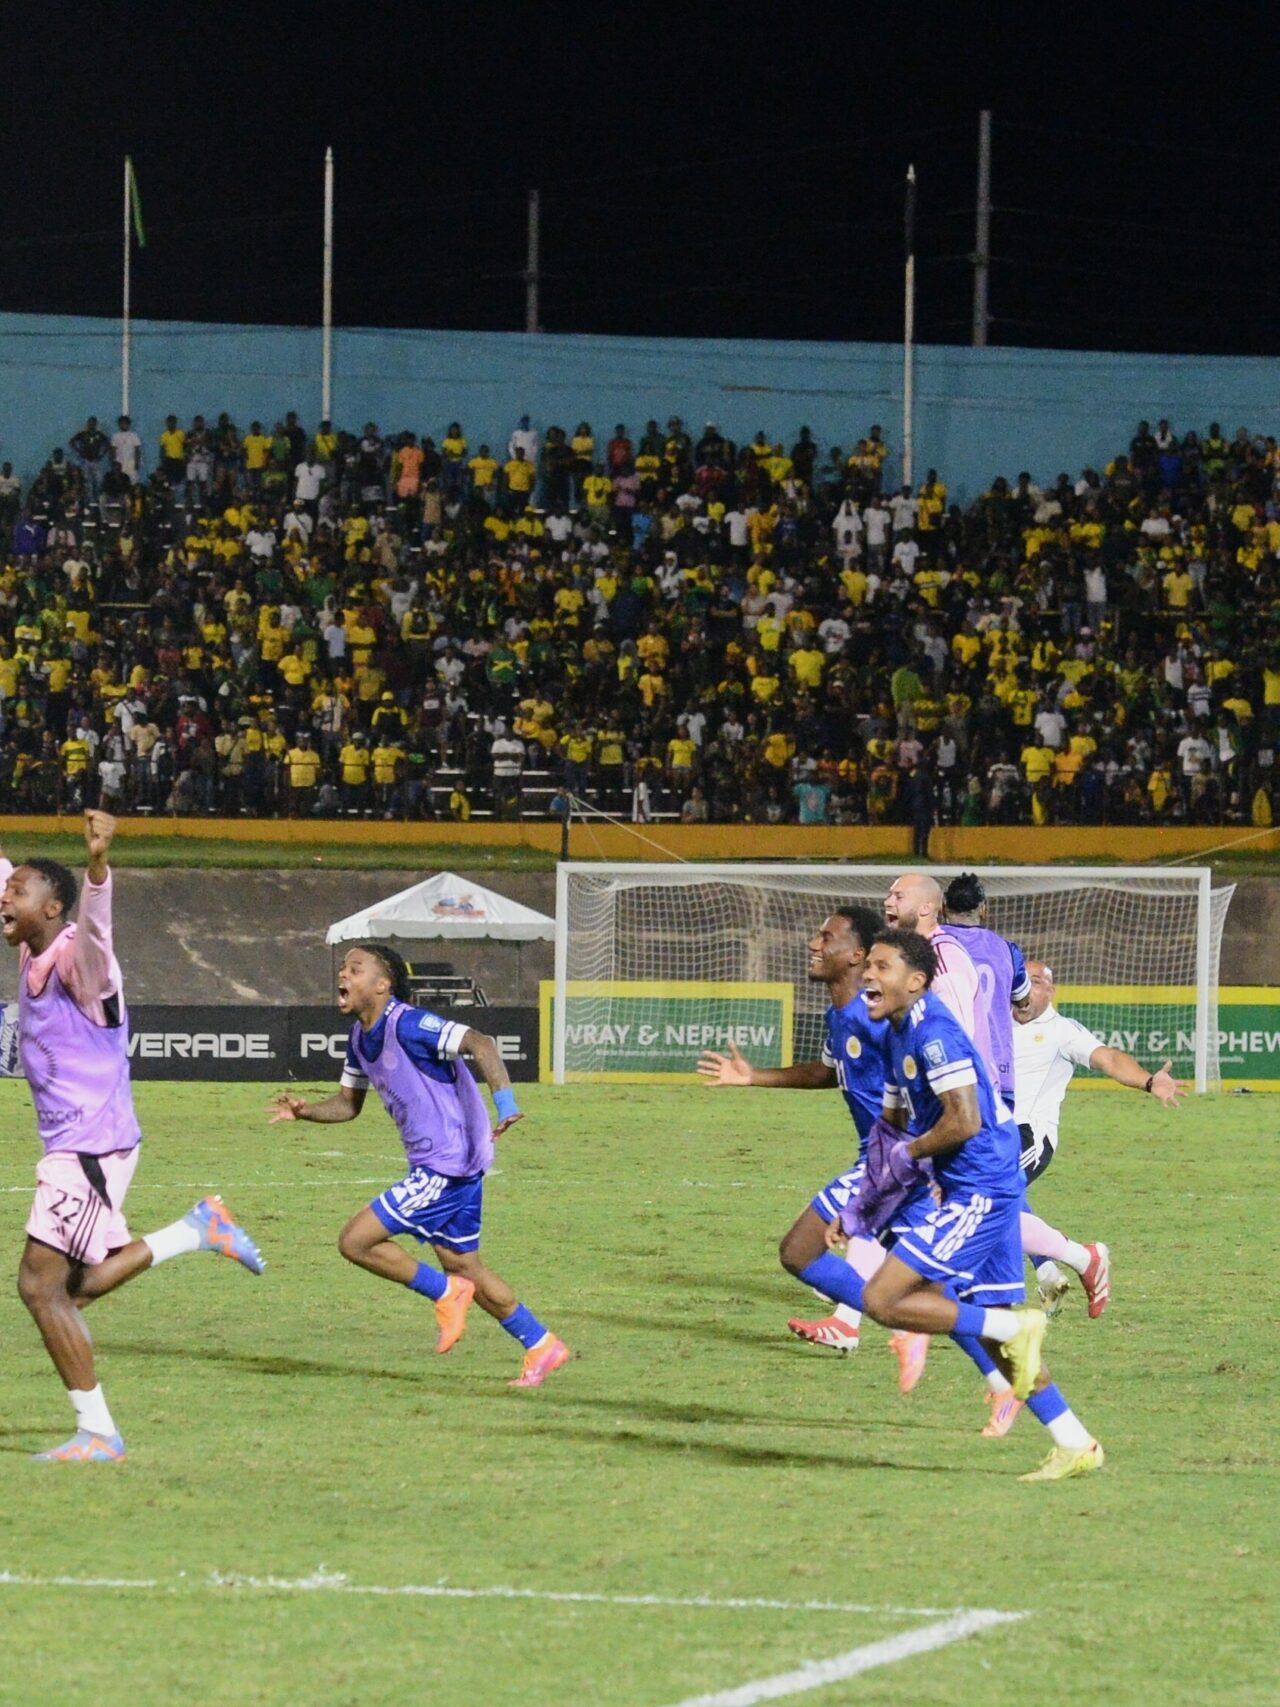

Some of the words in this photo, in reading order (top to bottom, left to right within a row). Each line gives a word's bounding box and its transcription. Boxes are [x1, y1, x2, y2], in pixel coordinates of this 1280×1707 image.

[566, 1024, 630, 1045] WRAY
[638, 1025, 659, 1046] &
[666, 1026, 776, 1047] NEPHEW
[1148, 1031, 1170, 1052] &
[1176, 1031, 1280, 1053] NPHEW
